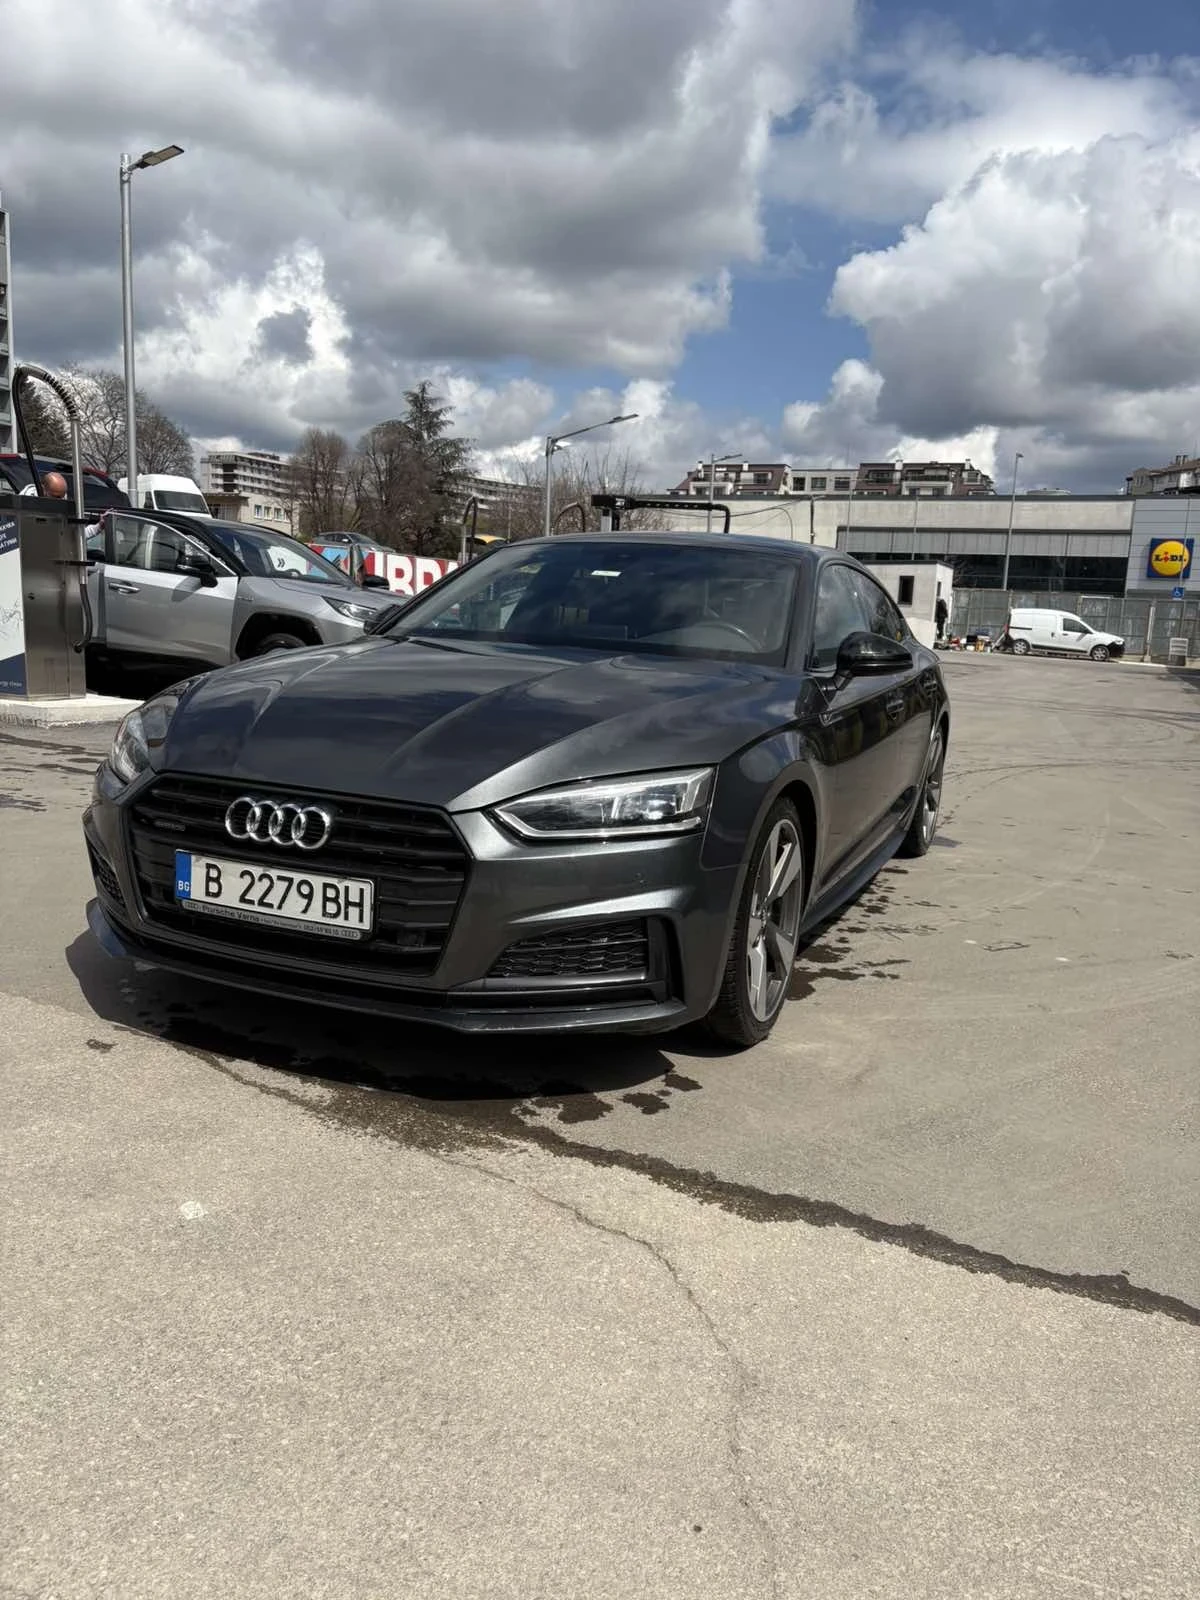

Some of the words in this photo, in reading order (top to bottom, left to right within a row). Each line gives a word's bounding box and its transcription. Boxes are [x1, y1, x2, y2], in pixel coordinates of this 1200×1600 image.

[178, 881, 190, 892] BG
[205, 862, 223, 898] B
[239, 870, 314, 913] 2279
[322, 883, 365, 923] BH
